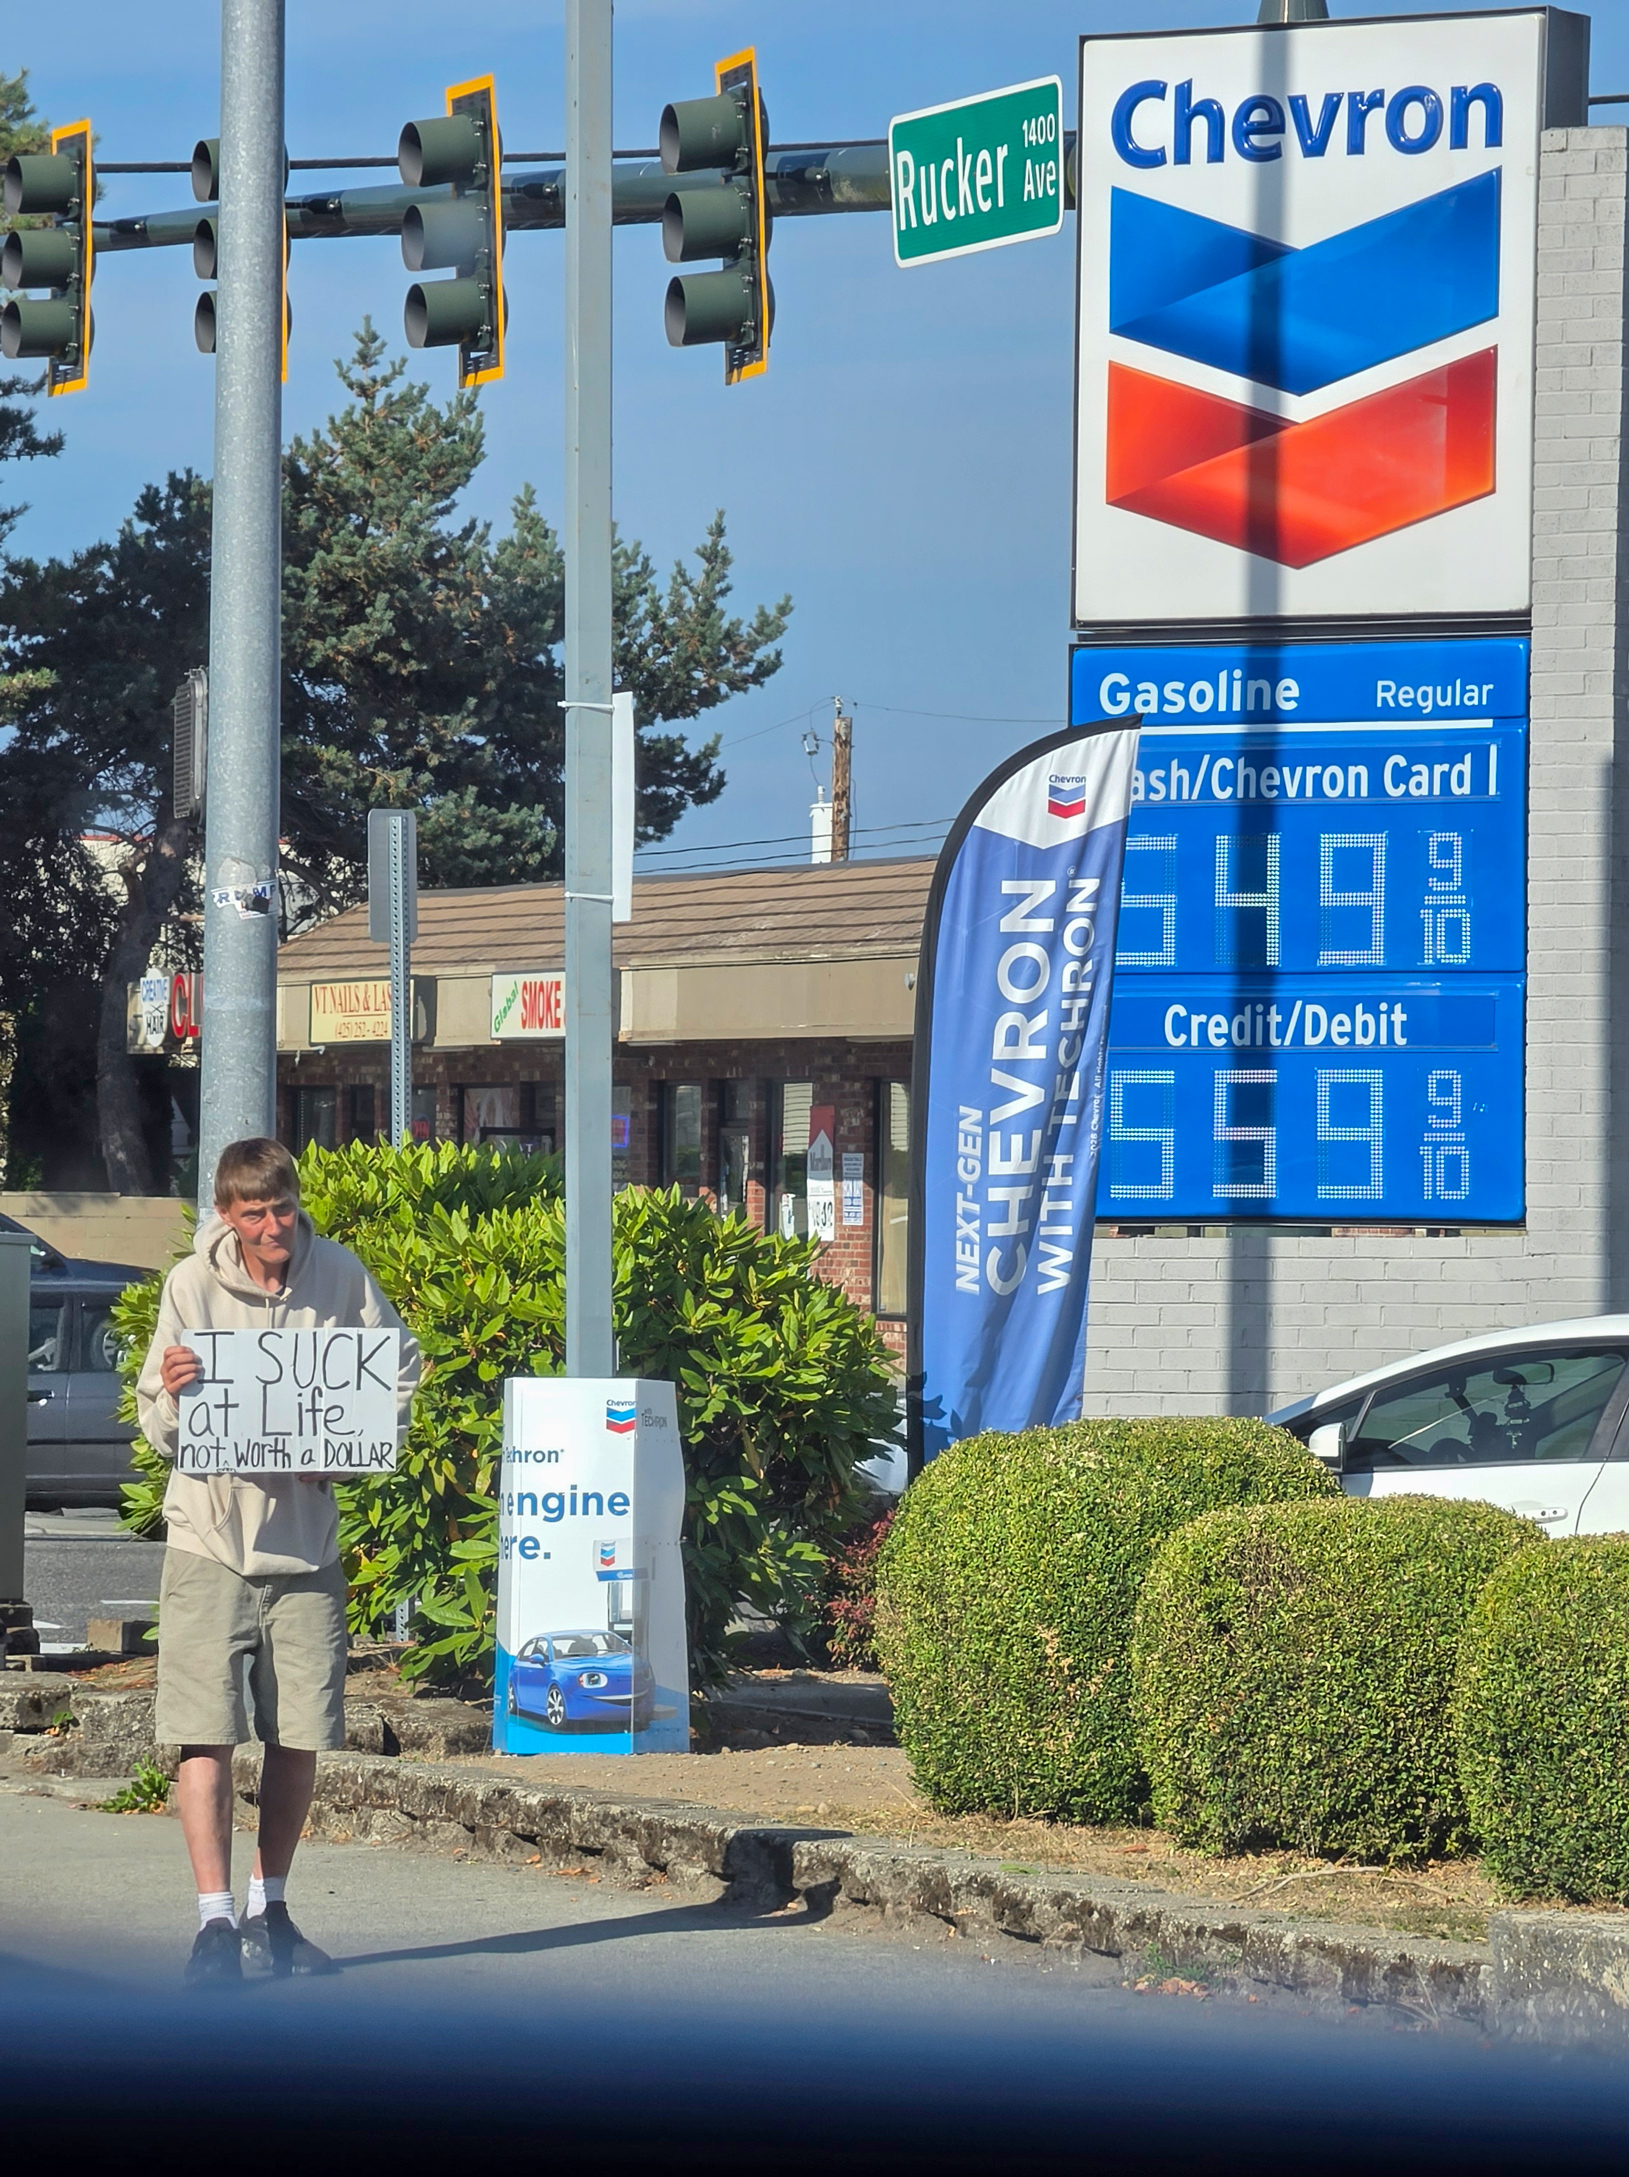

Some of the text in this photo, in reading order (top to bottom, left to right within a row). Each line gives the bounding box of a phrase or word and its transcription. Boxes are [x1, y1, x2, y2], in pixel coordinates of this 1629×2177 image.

[1022, 113, 1055, 148] 1400
[1110, 78, 1504, 170] Chevron
[896, 137, 1056, 231] Rucker Ave
[1099, 669, 1494, 716] Gasoline Regular
[1048, 774, 1087, 784] Chevron
[1131, 754, 1368, 801] ash/Chevron
[1383, 752, 1472, 797] Card
[314, 986, 327, 1014] VT
[330, 985, 360, 1014] NAILS
[362, 984, 371, 1012] &
[493, 980, 519, 1033] Global
[521, 980, 561, 1029] SMOKE
[1164, 1000, 1408, 1047] Credit/Debit
[146, 1014, 165, 1035] HAIR
[986, 880, 1056, 1296] CHEVRON
[956, 1105, 983, 1296] NEXT-GEN
[1037, 1154, 1074, 1295] WITH
[194, 1331, 392, 1391] I SUCK
[188, 1388, 240, 1437] at
[180, 1437, 226, 1469] not
[300, 1449, 316, 1466] a
[324, 1437, 396, 1470] DOLLAR
[507, 1485, 630, 1523] engine
